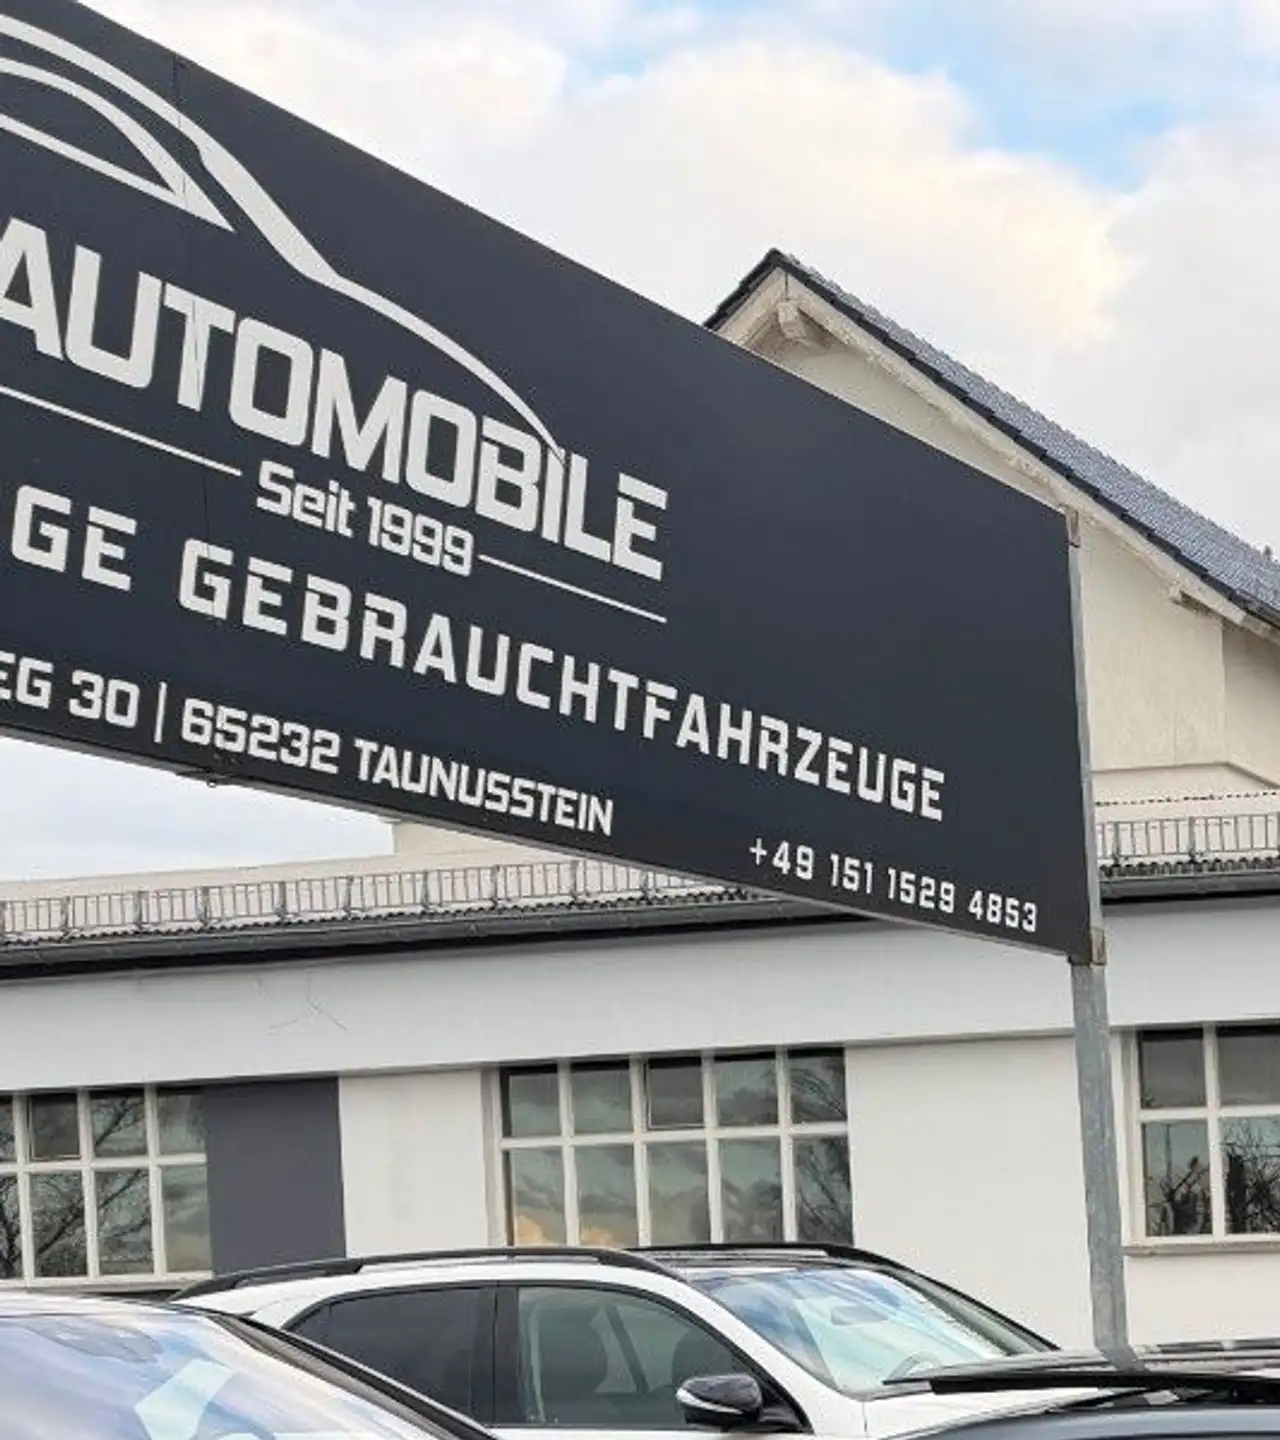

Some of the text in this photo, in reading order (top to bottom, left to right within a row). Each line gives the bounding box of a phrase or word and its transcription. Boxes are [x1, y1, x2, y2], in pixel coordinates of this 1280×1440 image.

[0, 217, 668, 580] AUTOMOBILE
[256, 460, 474, 577] Seit 1999
[11, 485, 945, 821] GE GEBRAUCHTFAHRZEUGE
[69, 669, 140, 728] 30
[181, 698, 341, 775] 65232
[354, 738, 613, 836] TAUNUSSTEIN
[749, 838, 1038, 933] +49 151 1529 4853
